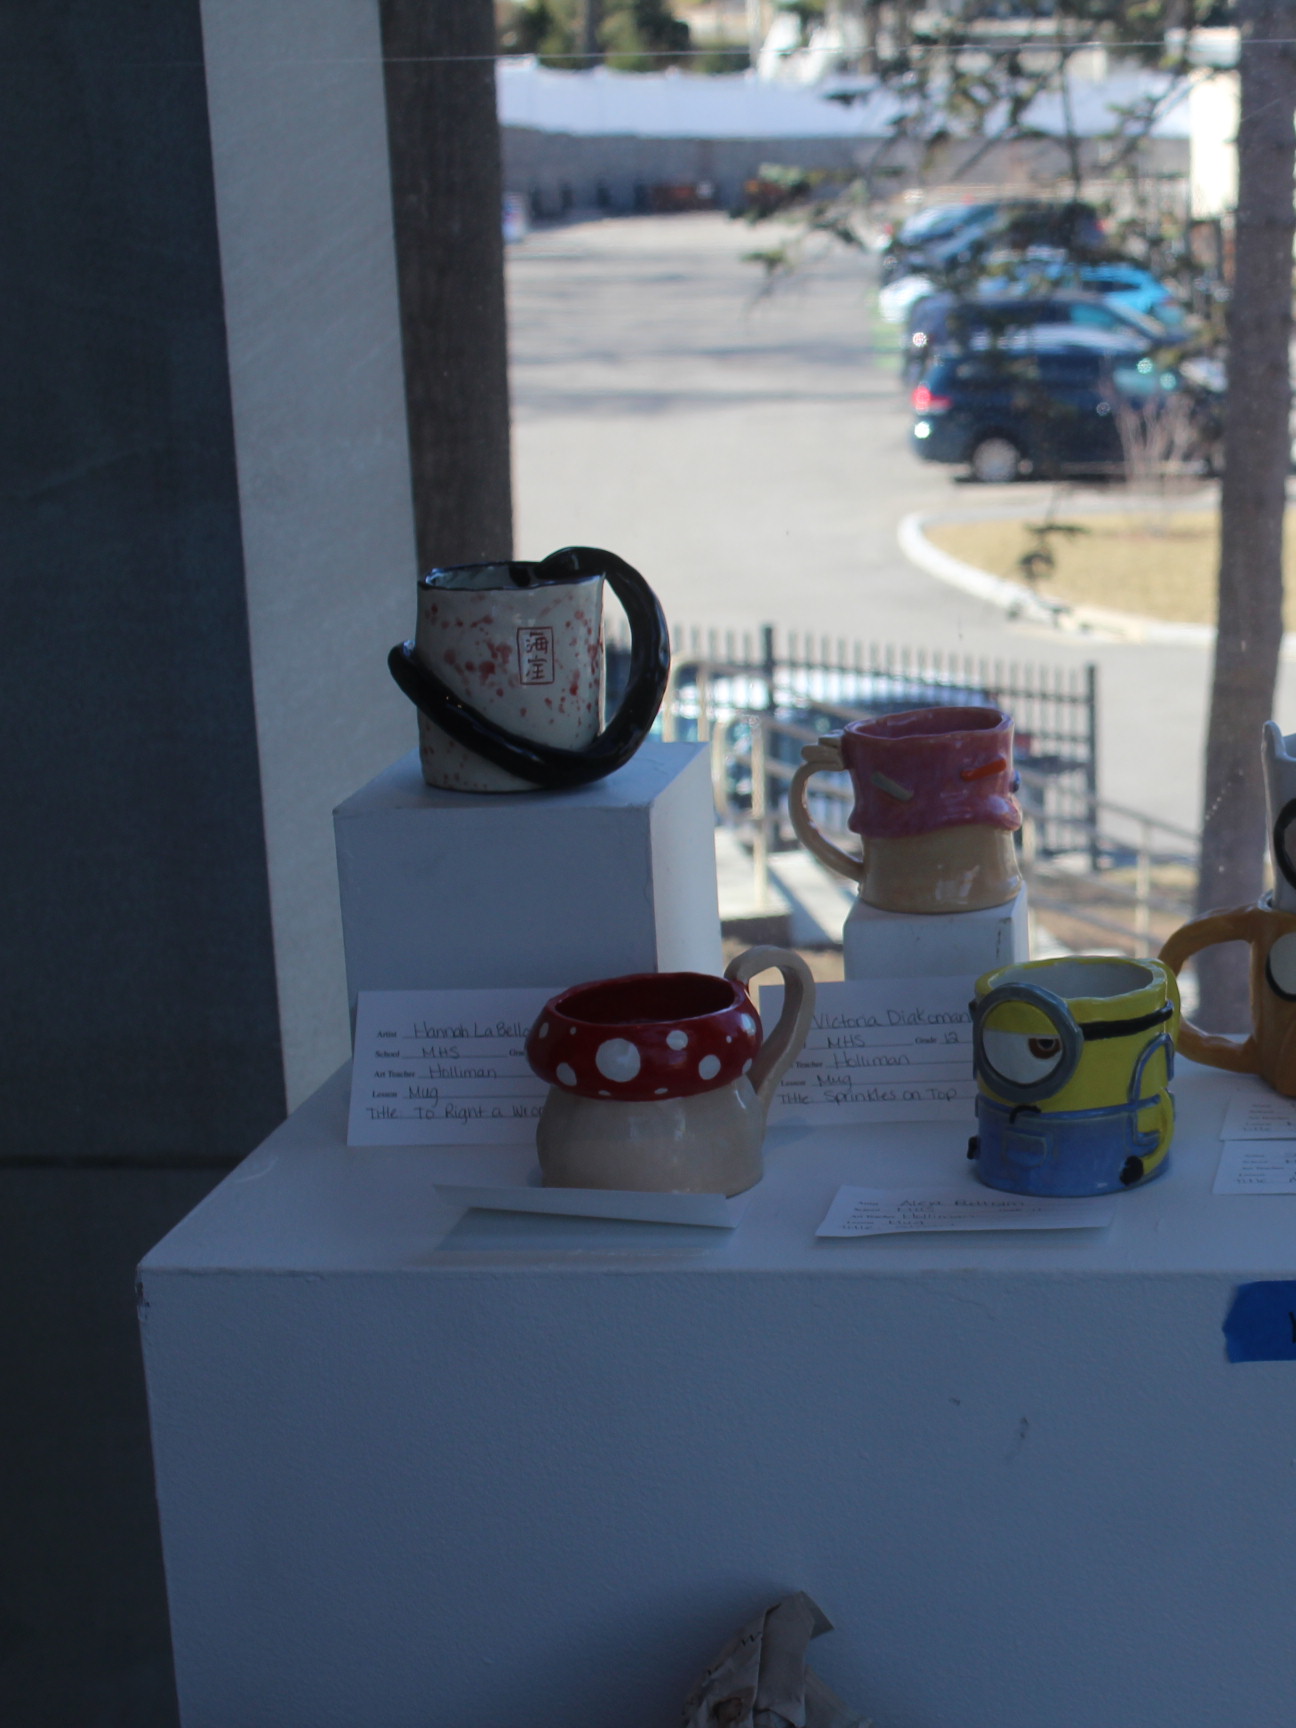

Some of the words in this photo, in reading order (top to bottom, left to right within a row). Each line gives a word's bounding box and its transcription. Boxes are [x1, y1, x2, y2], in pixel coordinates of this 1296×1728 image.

[375, 1030, 398, 1039] Artist
[413, 1021, 470, 1039] Hannah
[812, 1012, 879, 1030] Victoria
[827, 1033, 866, 1049] MHS
[914, 1035, 938, 1045] Grade
[944, 1030, 960, 1044] 12
[374, 1049, 401, 1058] School
[421, 1045, 462, 1060] MHS
[833, 1051, 911, 1070] Holliman
[373, 1070, 387, 1079] Art
[387, 1069, 416, 1079] Teacher
[428, 1063, 498, 1080] Holliman
[816, 1073, 853, 1095] Mug
[408, 1085, 440, 1108] Mug
[823, 1087, 897, 1107] Sprinkles
[902, 1090, 921, 1102] on
[924, 1087, 958, 1103] Top
[413, 1106, 435, 1121] To
[444, 1102, 485, 1126] Right
[491, 1106, 503, 1119] a
